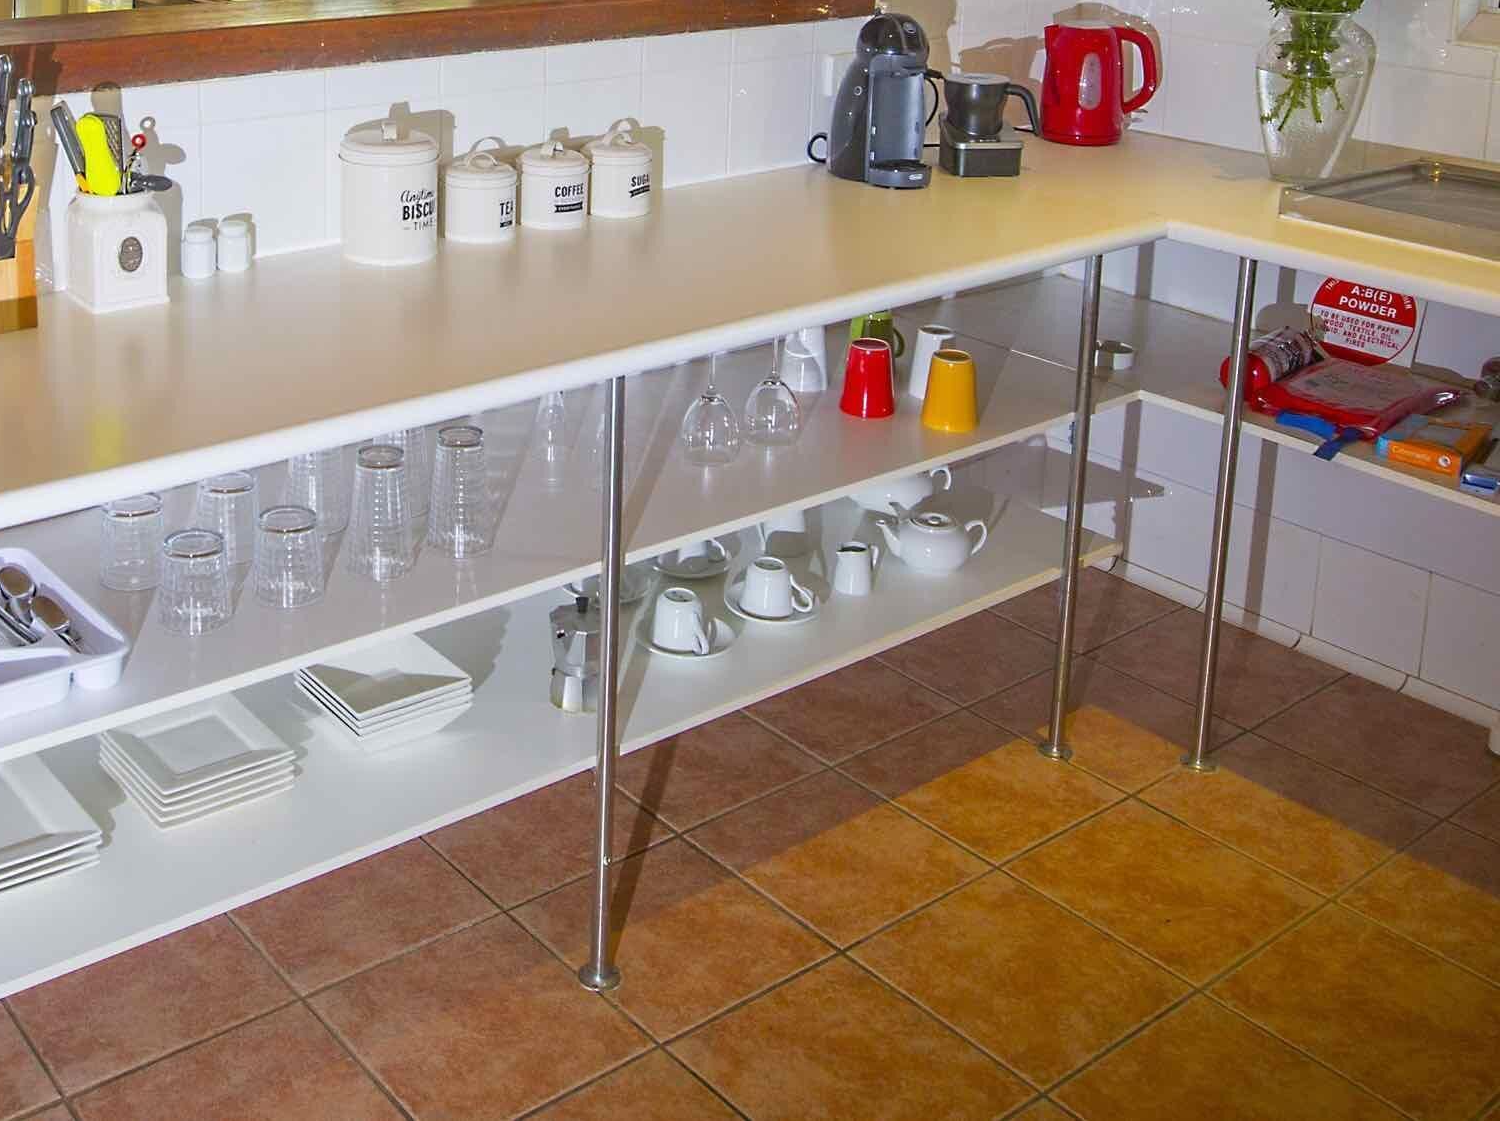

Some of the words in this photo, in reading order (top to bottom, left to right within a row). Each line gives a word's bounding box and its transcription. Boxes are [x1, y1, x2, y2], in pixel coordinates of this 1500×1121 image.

[555, 183, 583, 198] COFFEE
[403, 201, 435, 221] BISCU
[1339, 295, 1397, 318] POWDER
[1342, 315, 1359, 325] USED
